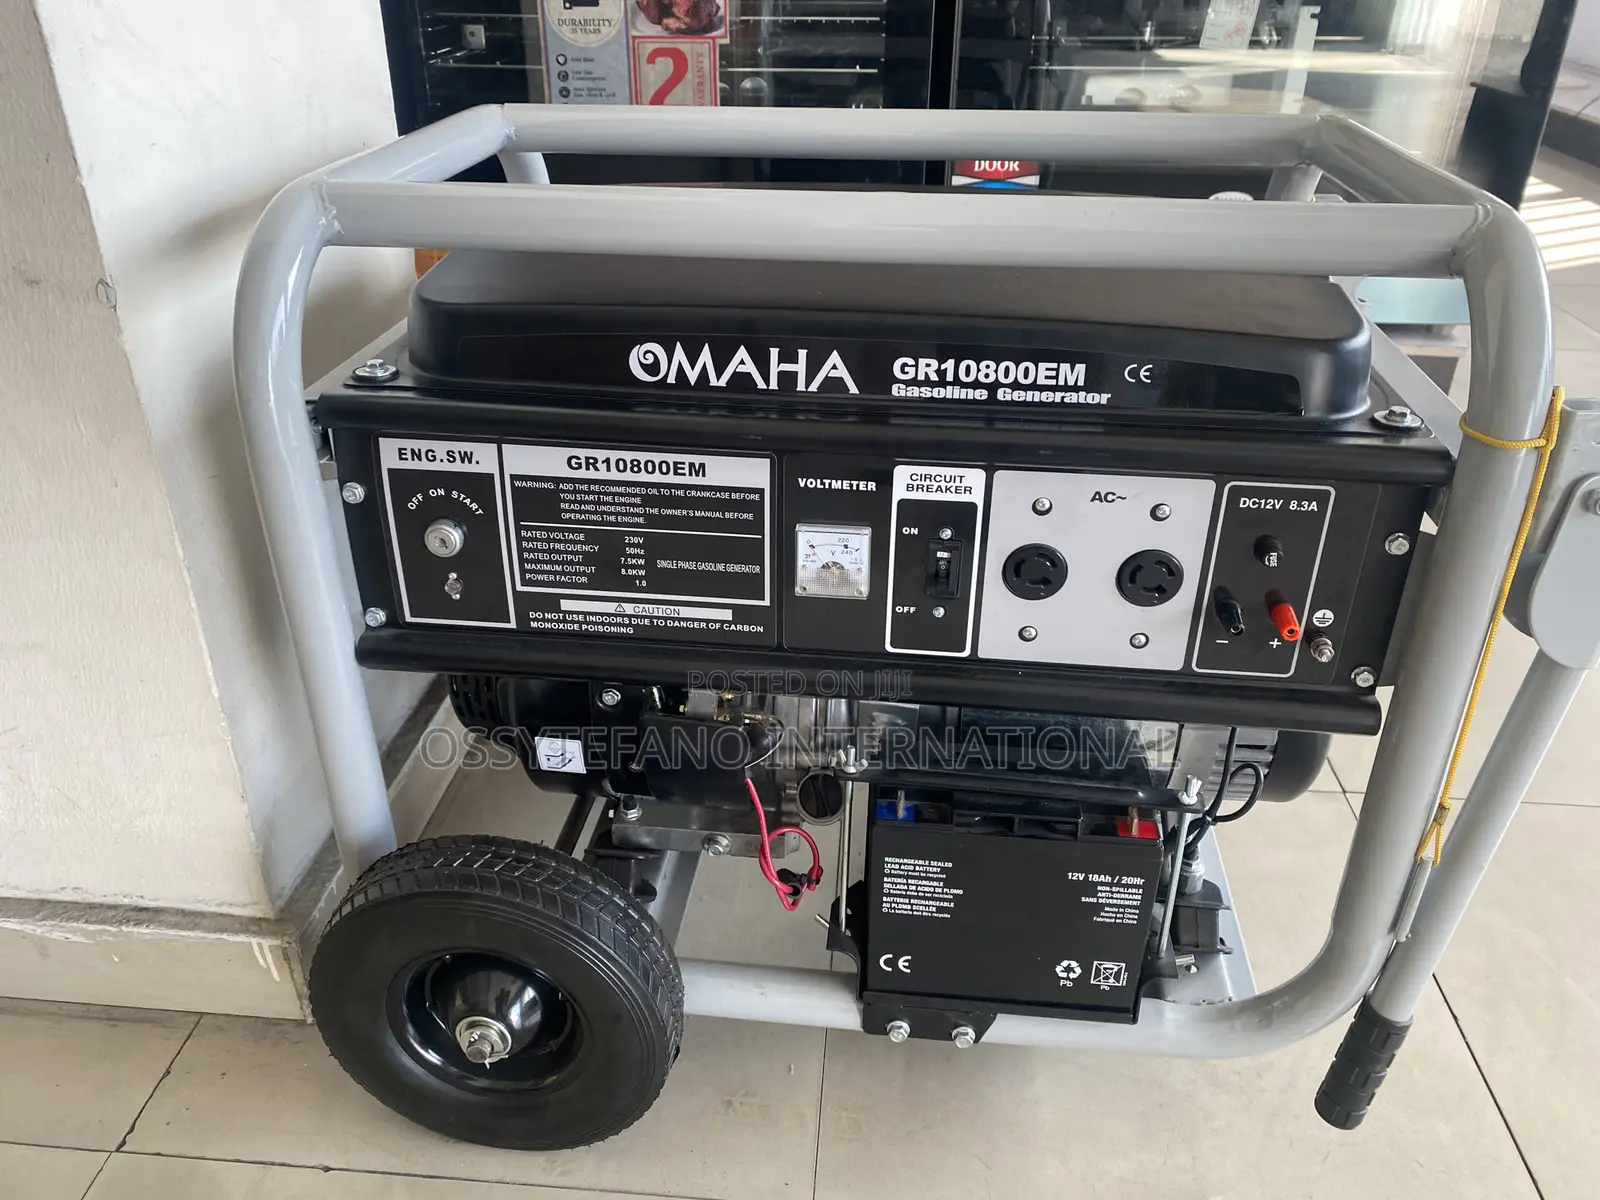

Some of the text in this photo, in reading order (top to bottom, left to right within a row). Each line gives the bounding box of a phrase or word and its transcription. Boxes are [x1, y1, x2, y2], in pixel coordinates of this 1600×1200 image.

[558, 18, 613, 27] DURABILITY
[646, 47, 688, 105] 2
[974, 160, 1020, 172] DOOR
[629, 341, 859, 394] OMAHA
[892, 357, 1086, 386] GR10800EM
[1124, 363, 1153, 384] CE
[892, 384, 1111, 406] Gasoline Generator
[398, 447, 480, 464] ENG.SW.
[566, 455, 706, 478] GR10800EM
[798, 478, 876, 491] VOLTMETER
[910, 473, 966, 484] CIRCUIT
[514, 480, 556, 489] WARNING:
[590, 485, 646, 494] RECOMMENDED
[686, 490, 730, 499] CRANKCASE
[732, 492, 760, 500] BEFORE
[906, 484, 972, 494] BREAKER
[408, 488, 484, 516] OFF ON START
[1239, 497, 1319, 512] DC12V 8.3A
[561, 512, 601, 521] OPERATING
[597, 505, 644, 514] UNDERSTAND
[695, 510, 724, 518] MANUAL
[725, 512, 754, 520] BEFORE
[521, 530, 585, 540] RATED VOLTAGE
[522, 541, 599, 552] RATED FREQUENCY
[524, 552, 583, 562] RATED OUTPUT
[1270, 552, 1278, 568] FUSE
[524, 562, 596, 573] MAXIMUM OUTPUT
[656, 560, 760, 574] SINGLE PHASE GASOLINE GENERATOR
[526, 574, 588, 584] POWER FACTOR
[633, 605, 680, 616] CAUTION
[896, 606, 916, 614] OFF
[530, 622, 634, 634] MONOXIDE POISONING
[586, 614, 630, 624] INDOORS
[632, 617, 650, 626] DUE
[667, 620, 706, 629] DANGER
[723, 623, 764, 632] CARBON
[884, 857, 929, 866] RECHARGEABLE
[1067, 872, 1086, 880] 12V
[1088, 874, 1112, 882] 18Ah
[1121, 876, 1146, 885] 20Hr
[1097, 886, 1144, 894] NON-SPILLABLE
[1097, 892, 1142, 900] ANTI-DERRAME
[910, 899, 954, 908] RECHARGEABLE
[879, 953, 912, 973] CE
